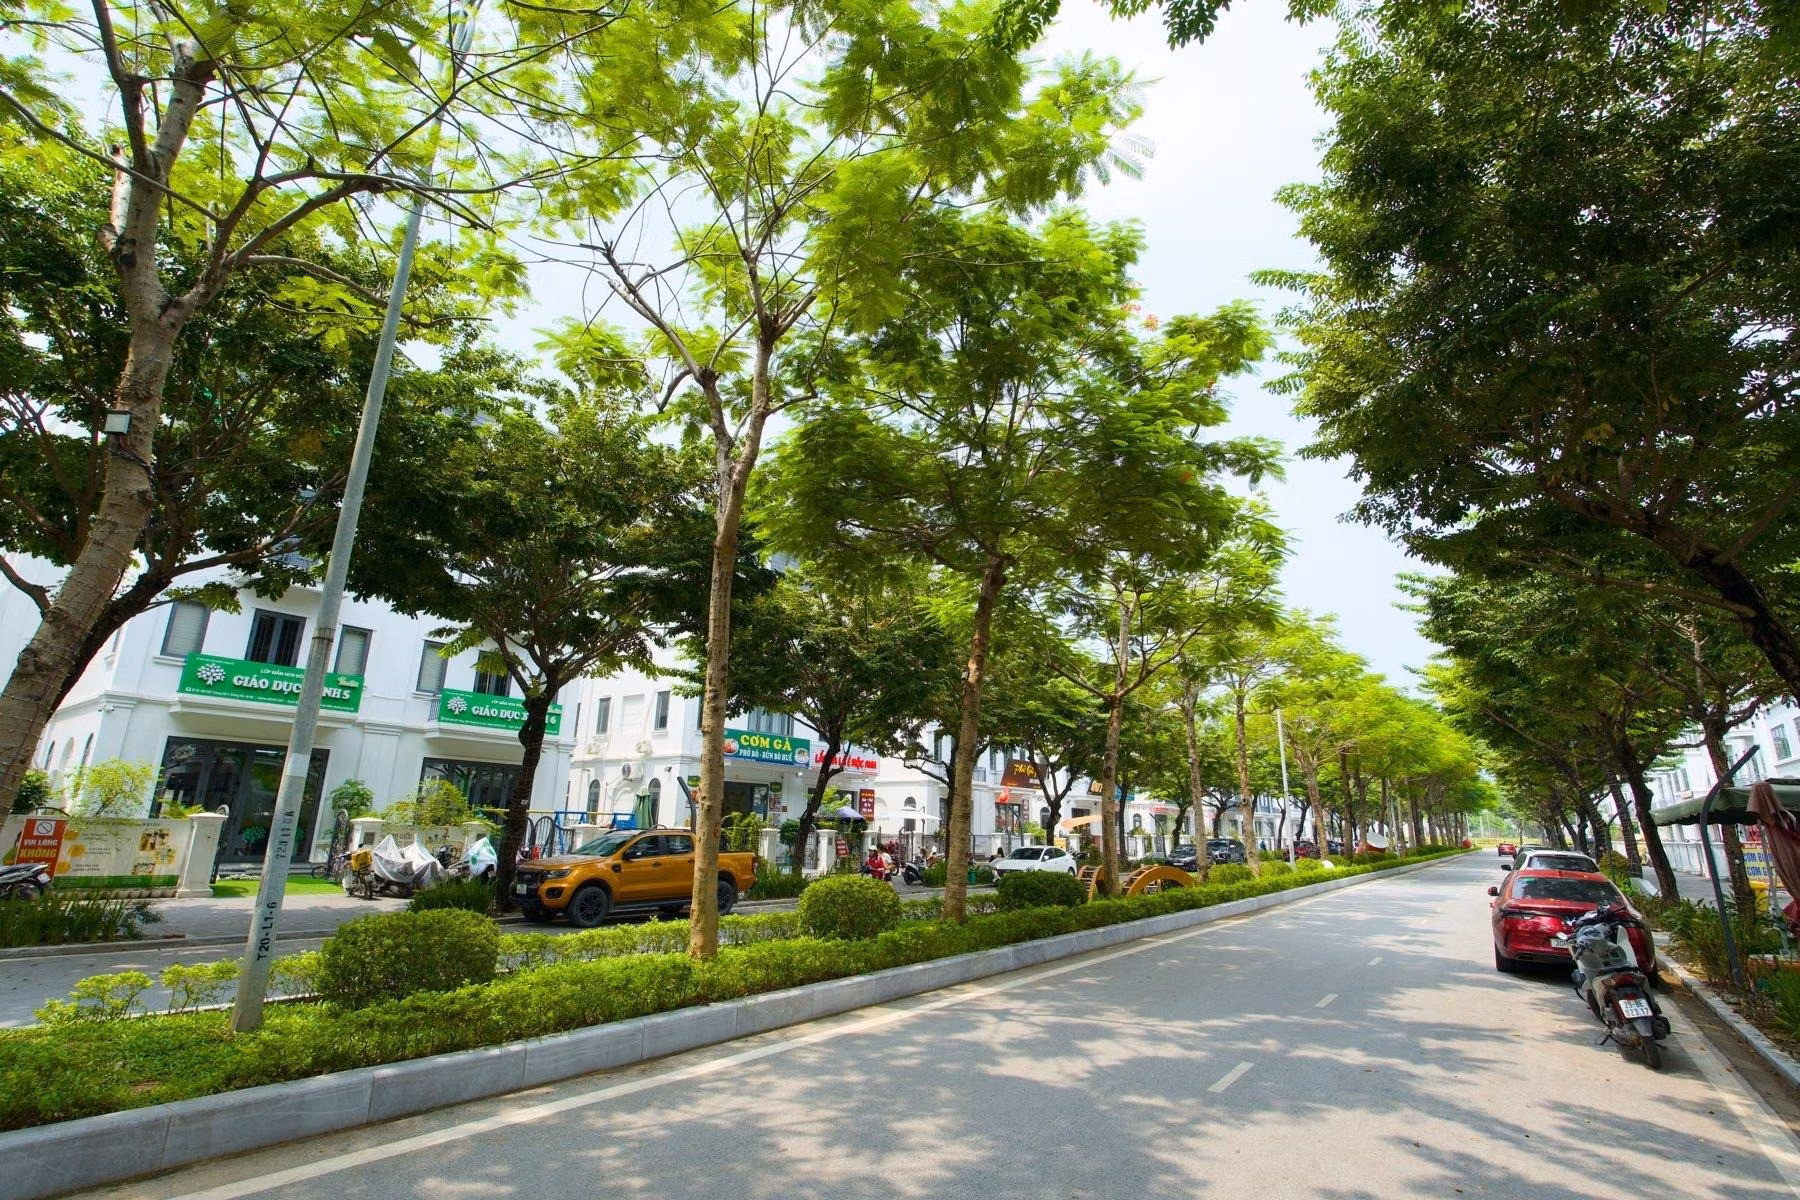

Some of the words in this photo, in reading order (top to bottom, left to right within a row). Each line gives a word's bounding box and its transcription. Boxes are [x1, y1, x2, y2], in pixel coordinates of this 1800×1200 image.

[232, 674, 270, 689] GIÁO
[471, 705, 498, 717] GIÁO
[499, 710, 520, 722] DỤC
[740, 733, 770, 749] CƠM
[773, 737, 793, 751] GÀ
[19, 847, 57, 858] KHÔNG
